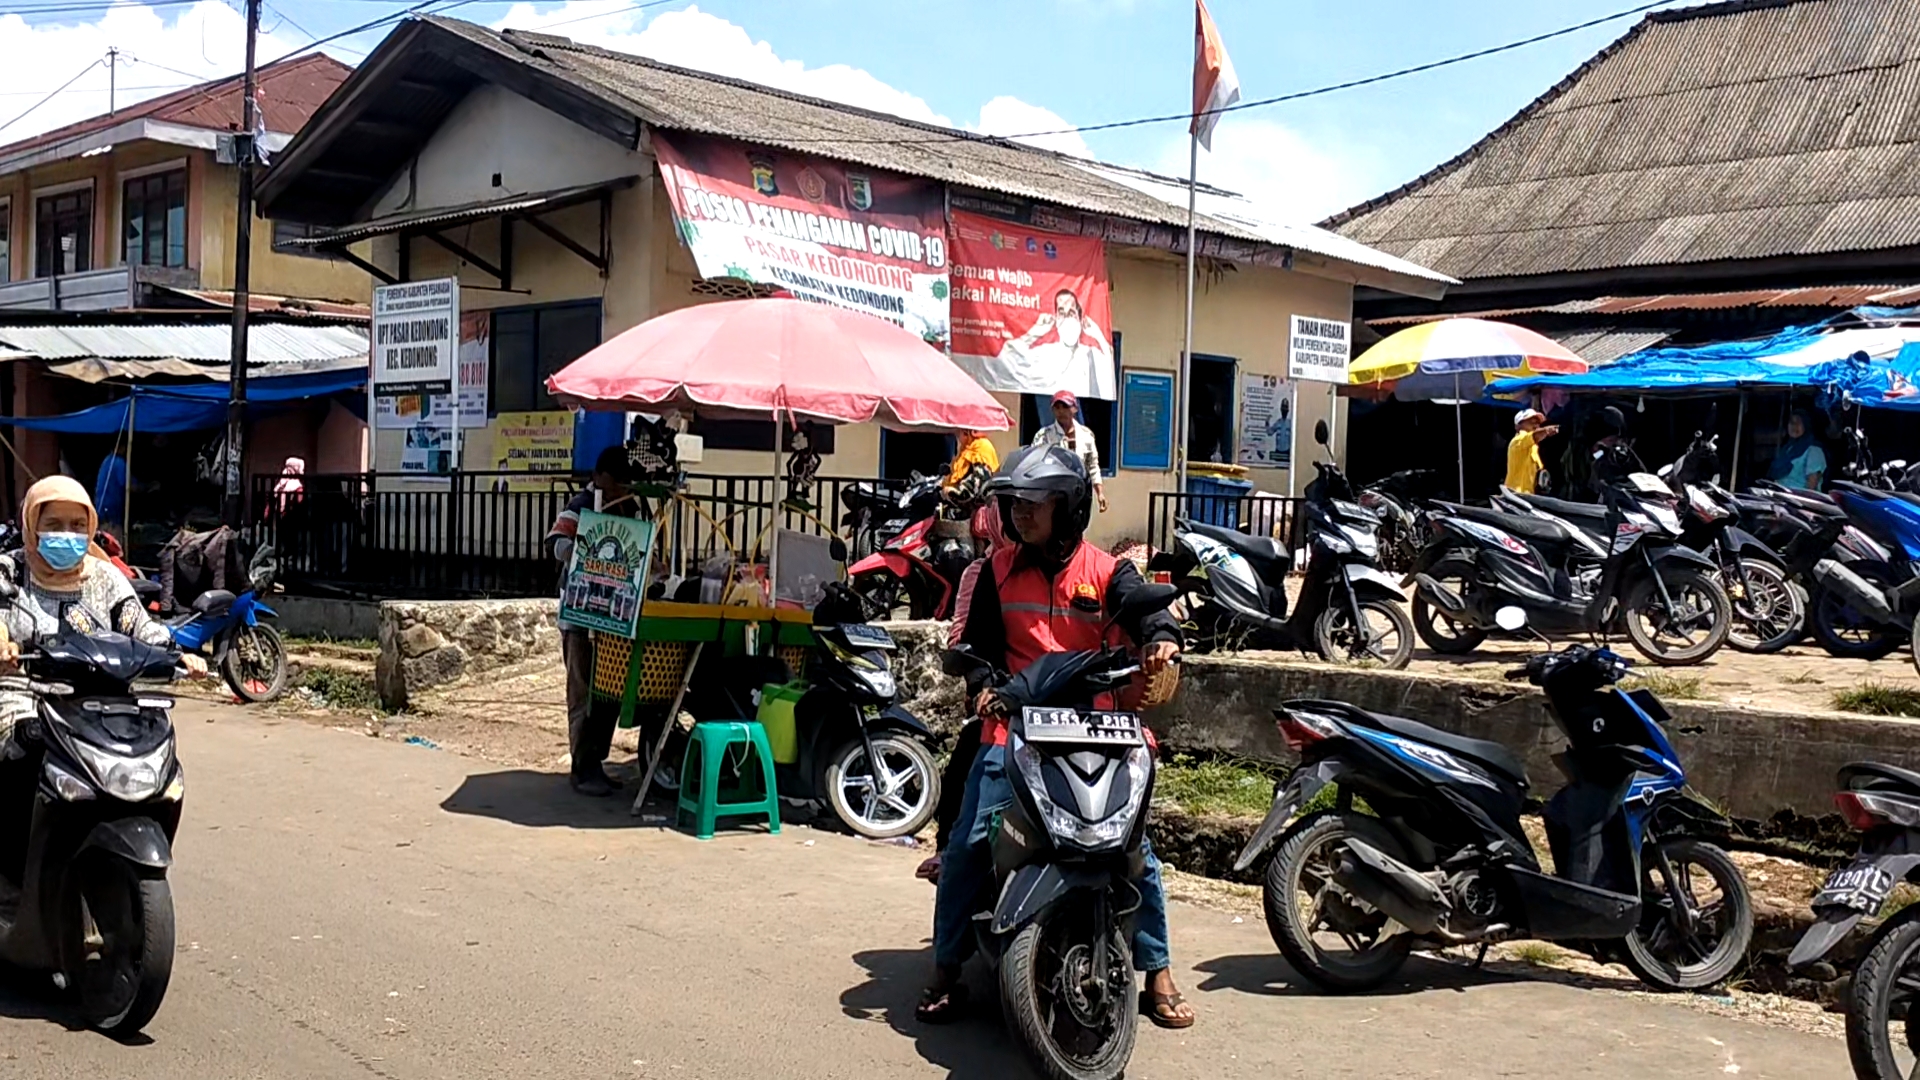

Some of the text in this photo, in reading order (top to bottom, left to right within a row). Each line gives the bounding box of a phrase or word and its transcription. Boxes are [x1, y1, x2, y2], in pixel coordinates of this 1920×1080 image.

[681, 187, 751, 227] POSKO
[747, 201, 868, 252] PENANGANAN
[867, 224, 945, 268] COVID-19
[743, 235, 914, 292] PASAR KEDONDONG
[948, 260, 1033, 289] Semua Wajib
[768, 264, 837, 297] KECAMATAN
[835, 284, 905, 315] KEDONDONG
[952, 285, 1041, 310] akai Masker!
[378, 317, 449, 344] UPT PASAR KEDONDONG
[1298, 319, 1345, 341] TANAH NEGARA
[400, 345, 438, 370] KEDONDONG
[584, 557, 628, 579] SARI RASA
